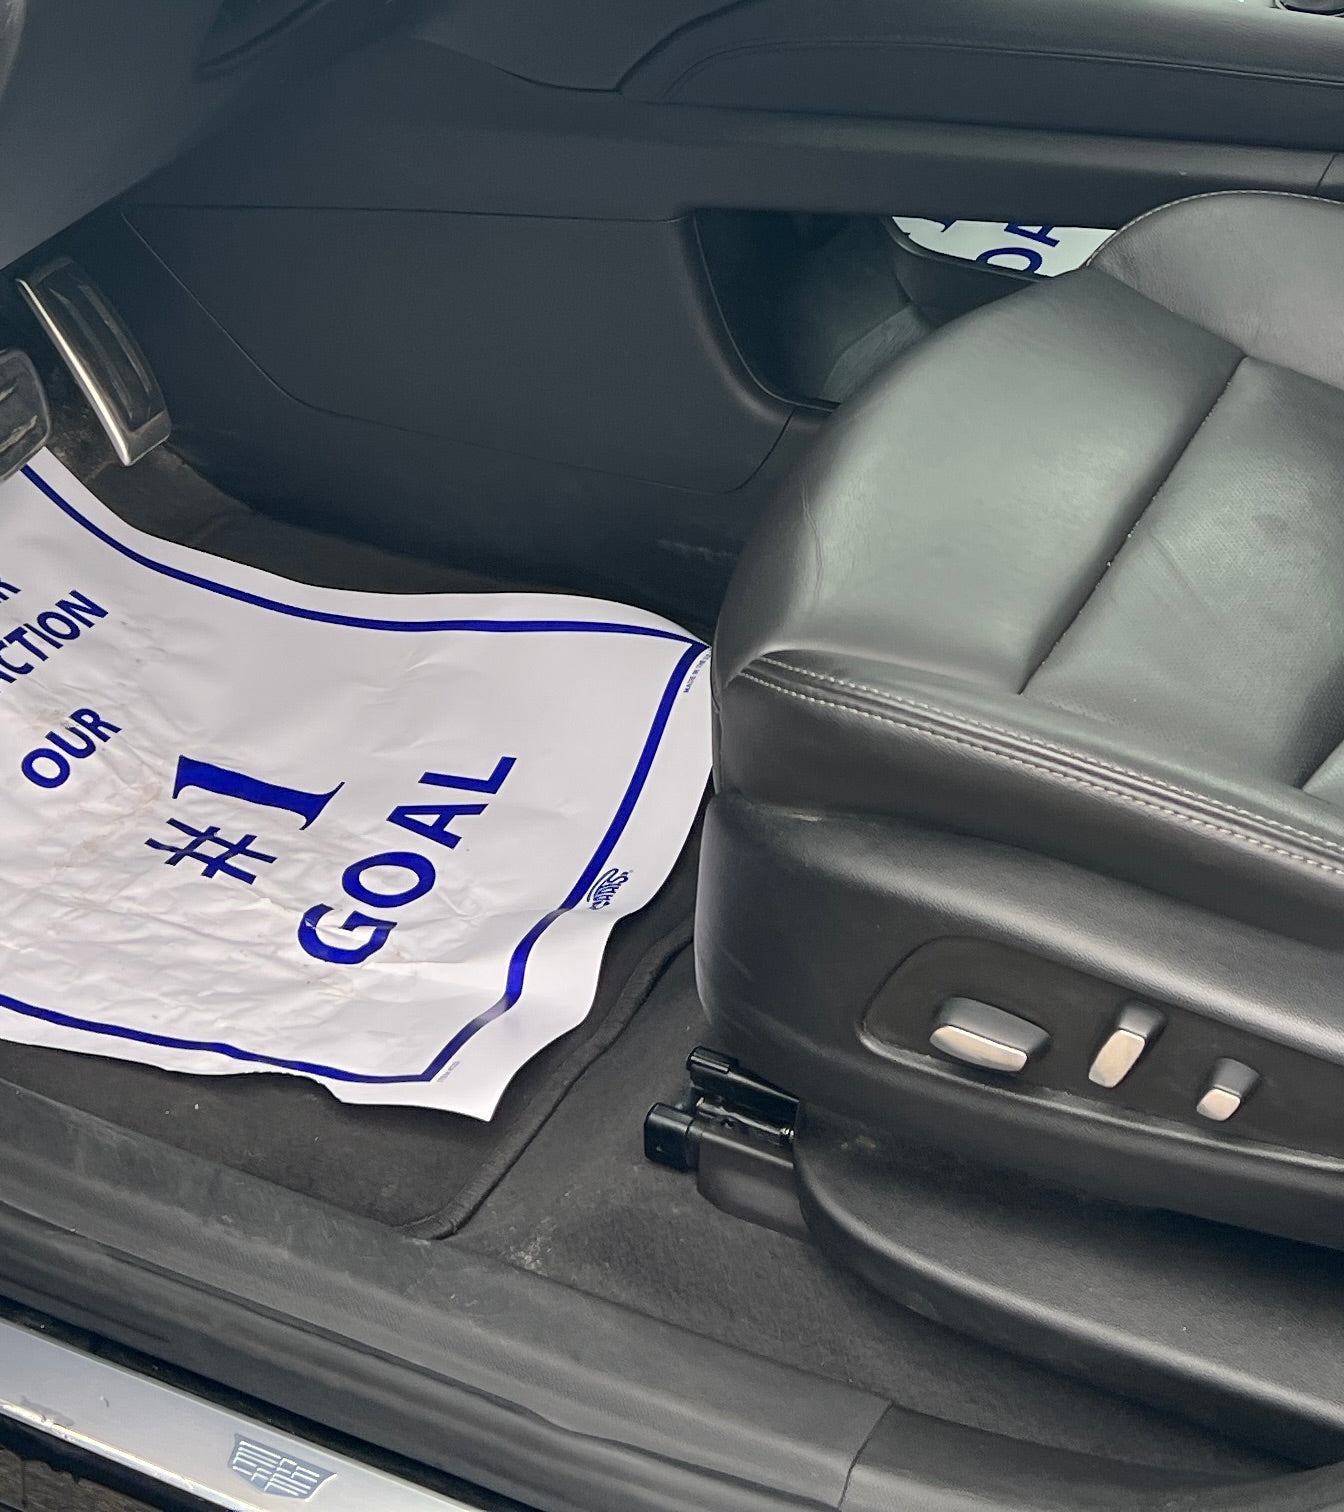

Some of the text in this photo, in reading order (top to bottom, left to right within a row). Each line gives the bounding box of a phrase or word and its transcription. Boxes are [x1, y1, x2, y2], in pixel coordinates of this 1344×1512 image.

[20, 708, 123, 789] OUR
[144, 754, 346, 886] #1
[297, 756, 517, 965] GOAL
